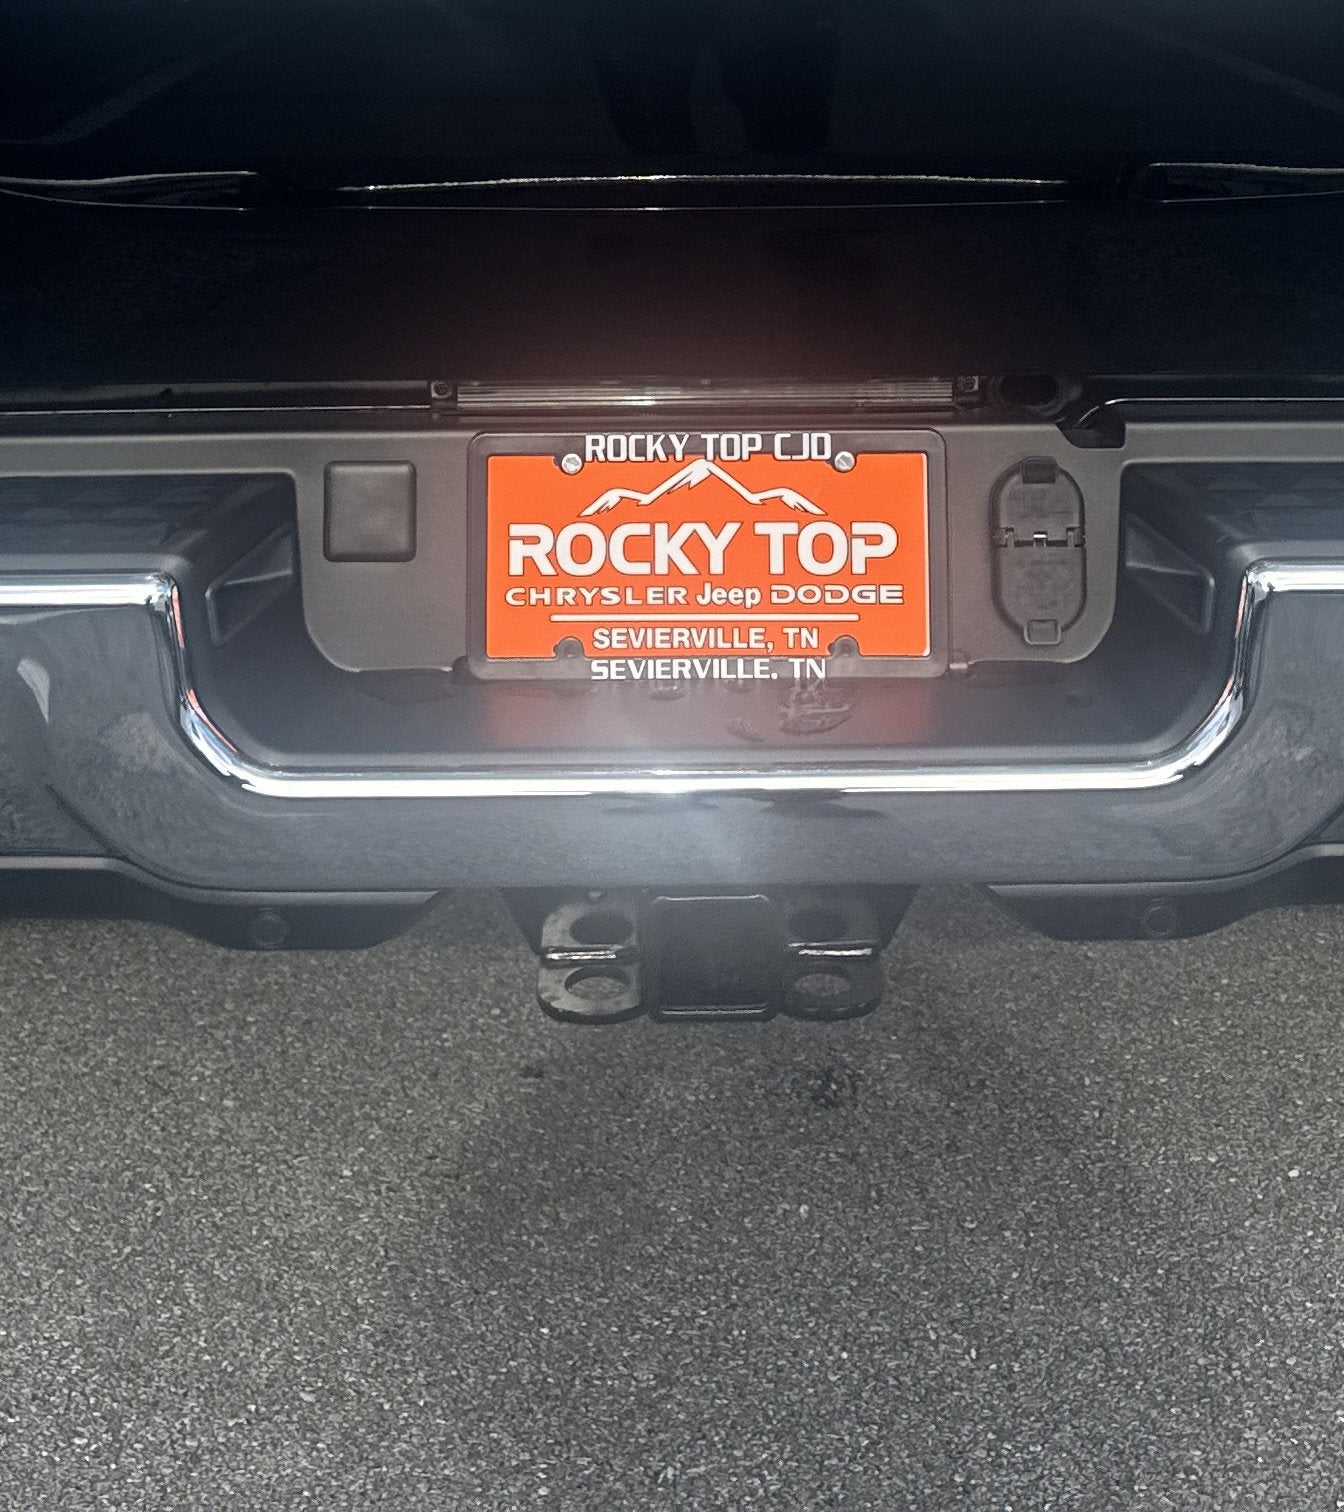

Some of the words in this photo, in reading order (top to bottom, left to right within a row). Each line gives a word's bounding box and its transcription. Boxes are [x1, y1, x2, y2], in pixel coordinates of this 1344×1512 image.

[585, 434, 689, 462] ROCKY
[701, 433, 762, 461] TOP
[774, 433, 832, 461] CJD
[508, 521, 743, 576] ROCKY
[754, 521, 899, 575] TOP
[504, 586, 688, 606] CHRYSLER
[695, 582, 761, 608] Jeep
[770, 584, 904, 605] DODGE
[593, 627, 774, 652] SEVIERVILLE,
[782, 627, 819, 649] TN
[788, 658, 826, 679] TN
